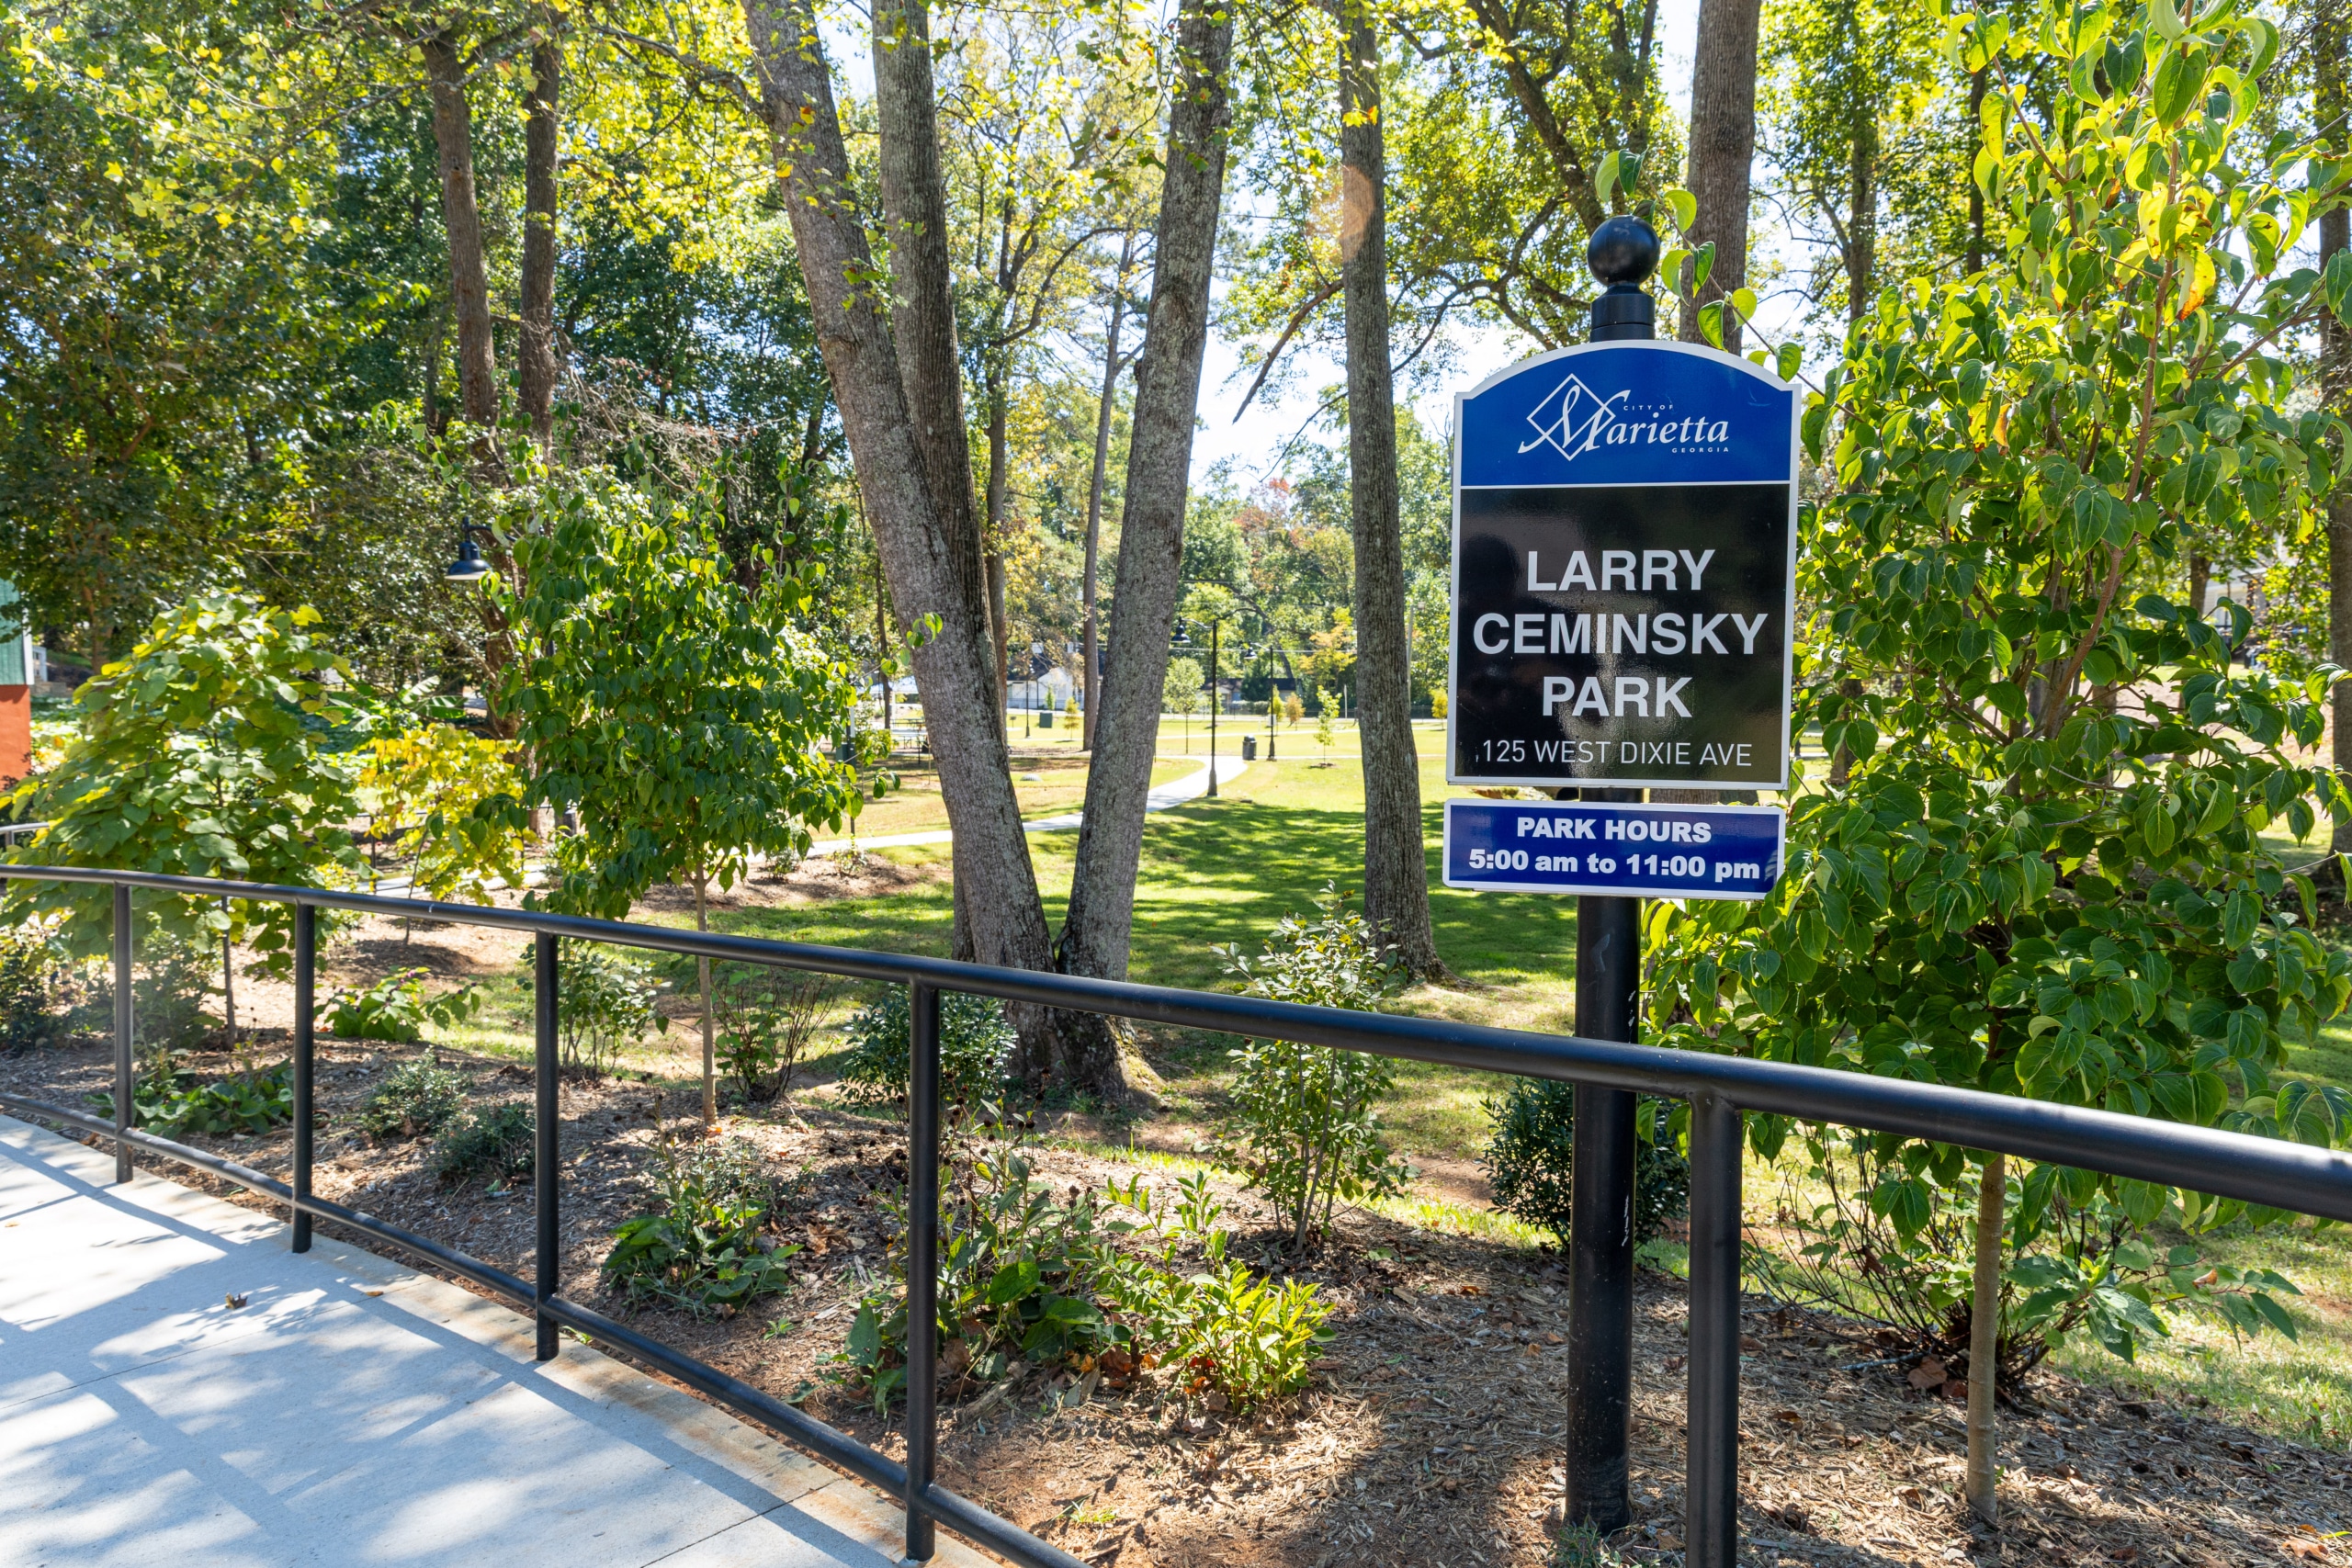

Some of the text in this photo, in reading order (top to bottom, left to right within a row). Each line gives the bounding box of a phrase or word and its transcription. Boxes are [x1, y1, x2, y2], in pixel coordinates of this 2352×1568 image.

[1517, 384, 1729, 454] Marietta
[1527, 549, 1715, 592] LARRY
[1473, 613, 1769, 655] CEMINSKY
[1543, 676, 1692, 718] PARK
[1483, 739, 1752, 767] 125 WEST DIXIE AVE
[1517, 817, 1712, 843] PARK HOURS
[1469, 849, 1760, 883] 5:00 am to 11:00 pm
